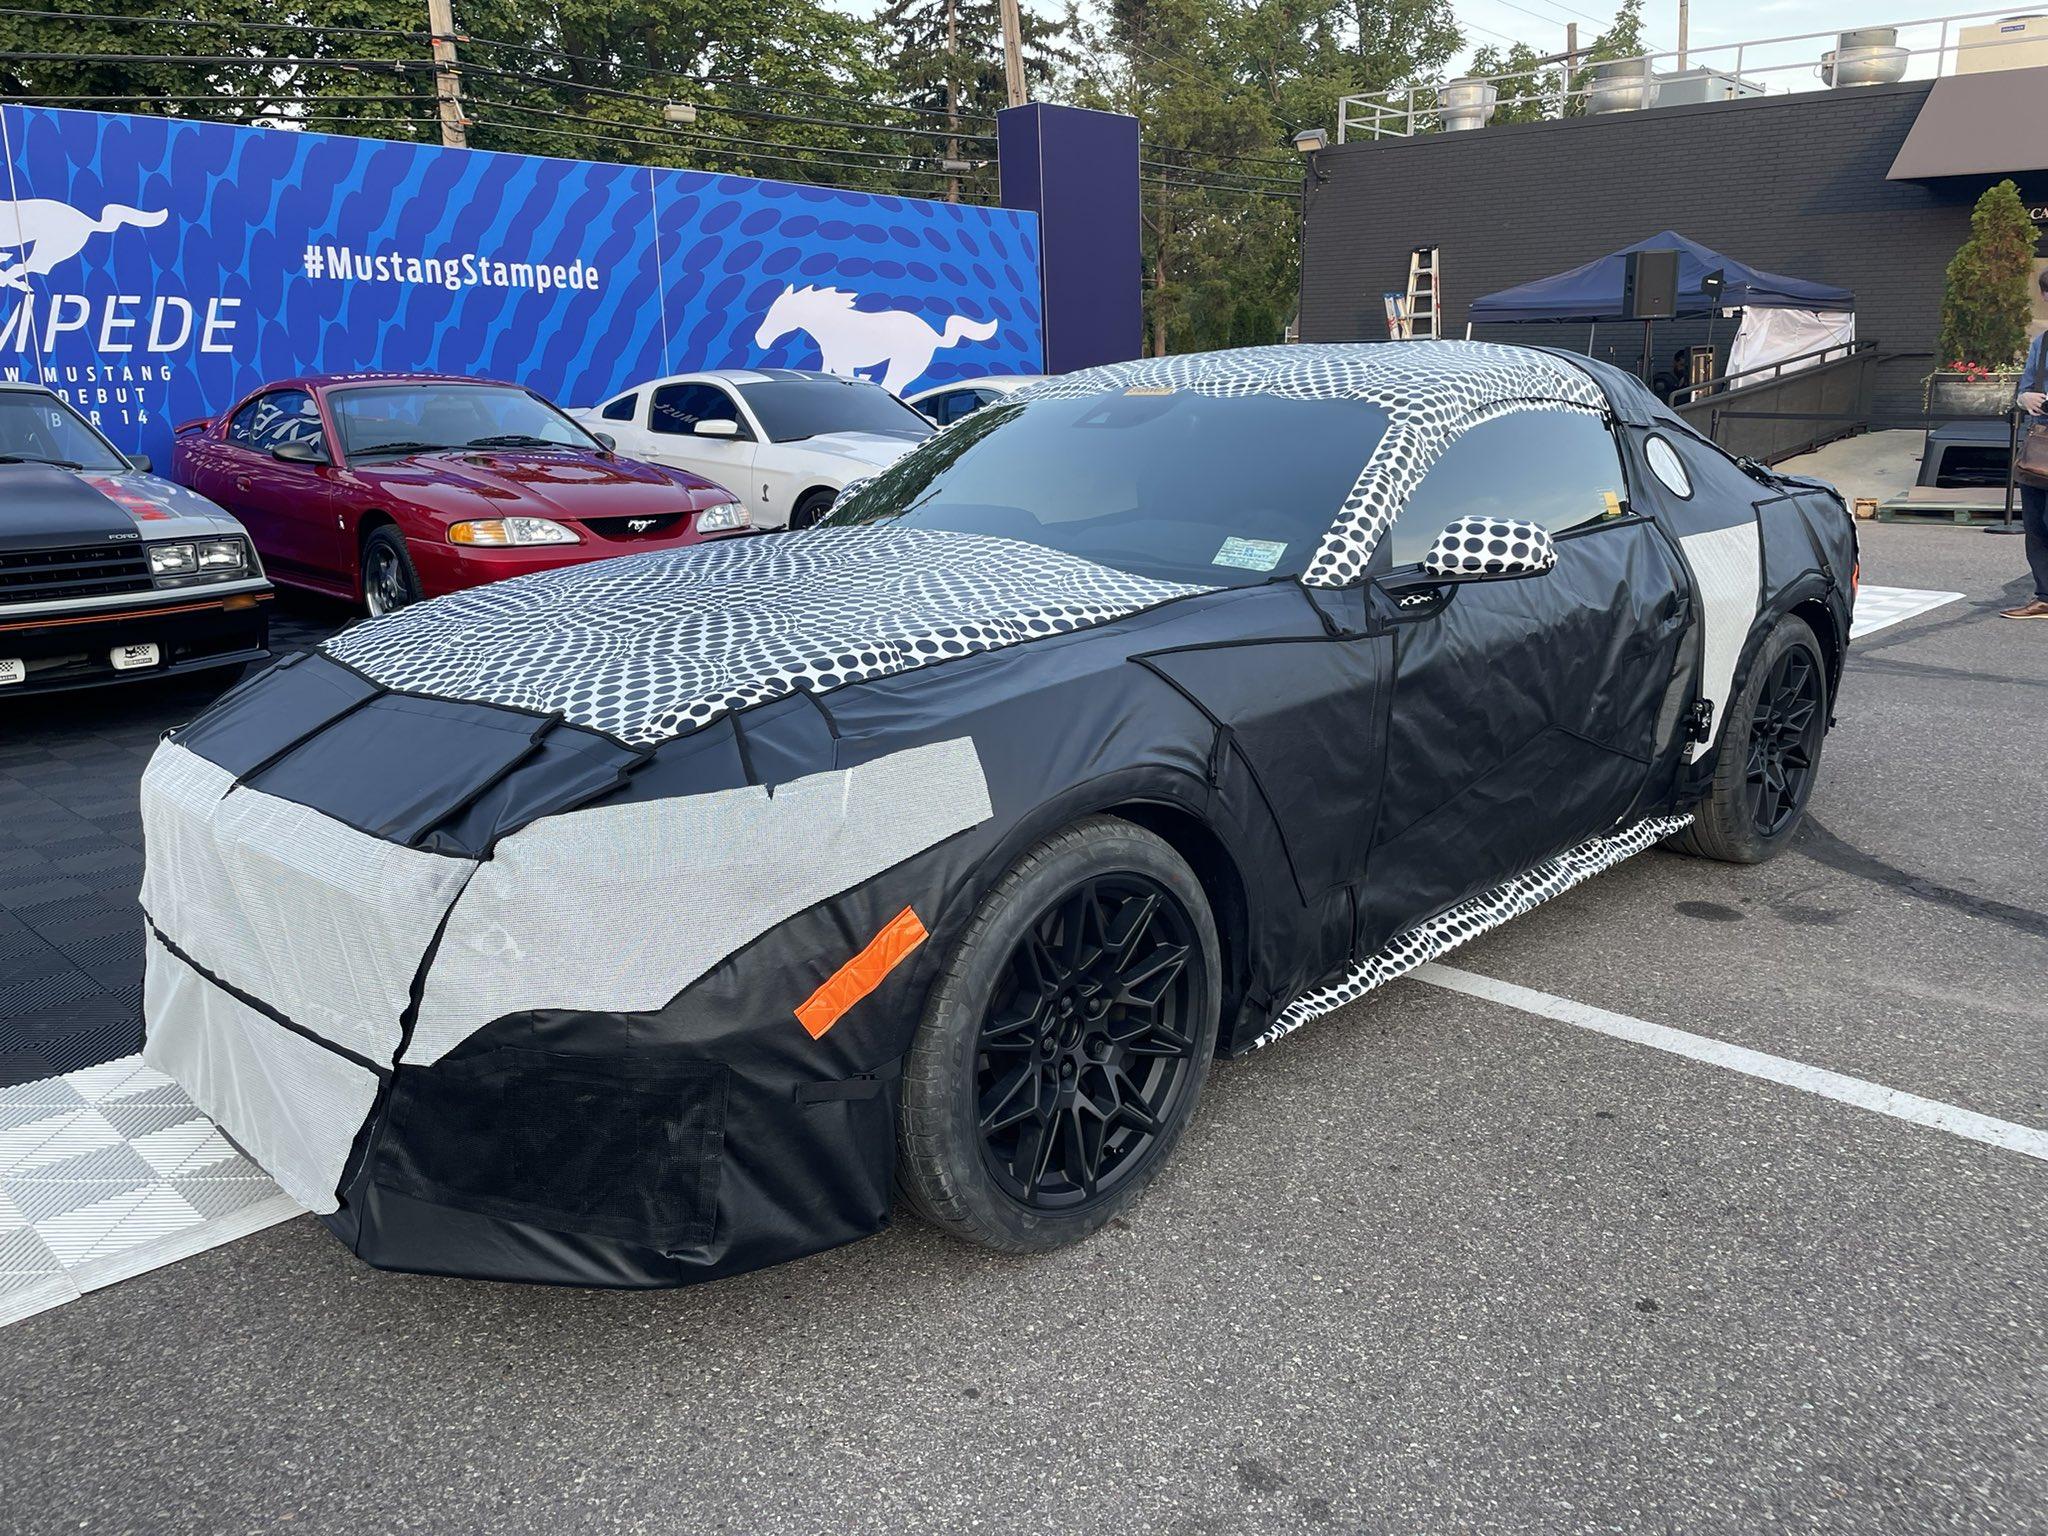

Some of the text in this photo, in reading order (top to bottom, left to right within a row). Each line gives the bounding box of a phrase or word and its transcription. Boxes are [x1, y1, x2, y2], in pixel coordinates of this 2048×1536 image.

[303, 245, 599, 293] #MustangStampede
[44, 365, 171, 382] MUSTANG
[57, 387, 145, 404] DEBUT
[121, 409, 147, 425] 14
